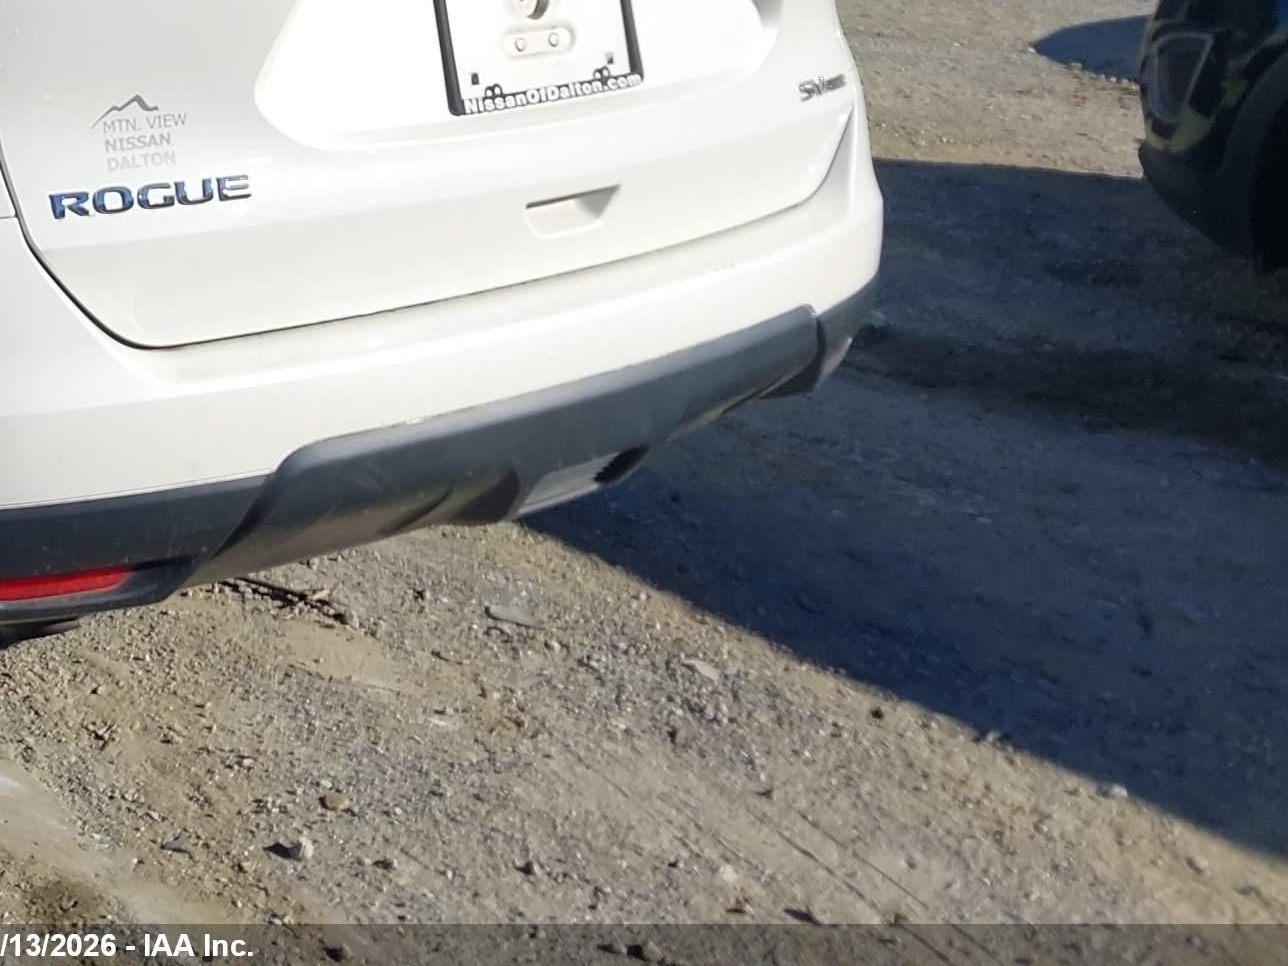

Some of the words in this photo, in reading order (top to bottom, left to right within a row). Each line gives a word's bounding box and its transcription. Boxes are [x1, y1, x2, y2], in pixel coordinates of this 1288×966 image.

[464, 73, 643, 115] NissanOfDalton.com
[103, 117, 142, 134] MTN.
[145, 112, 187, 129] VIEW
[105, 132, 171, 152] NISSAN
[107, 150, 176, 171] DALTON
[49, 174, 252, 220] ROGUE
